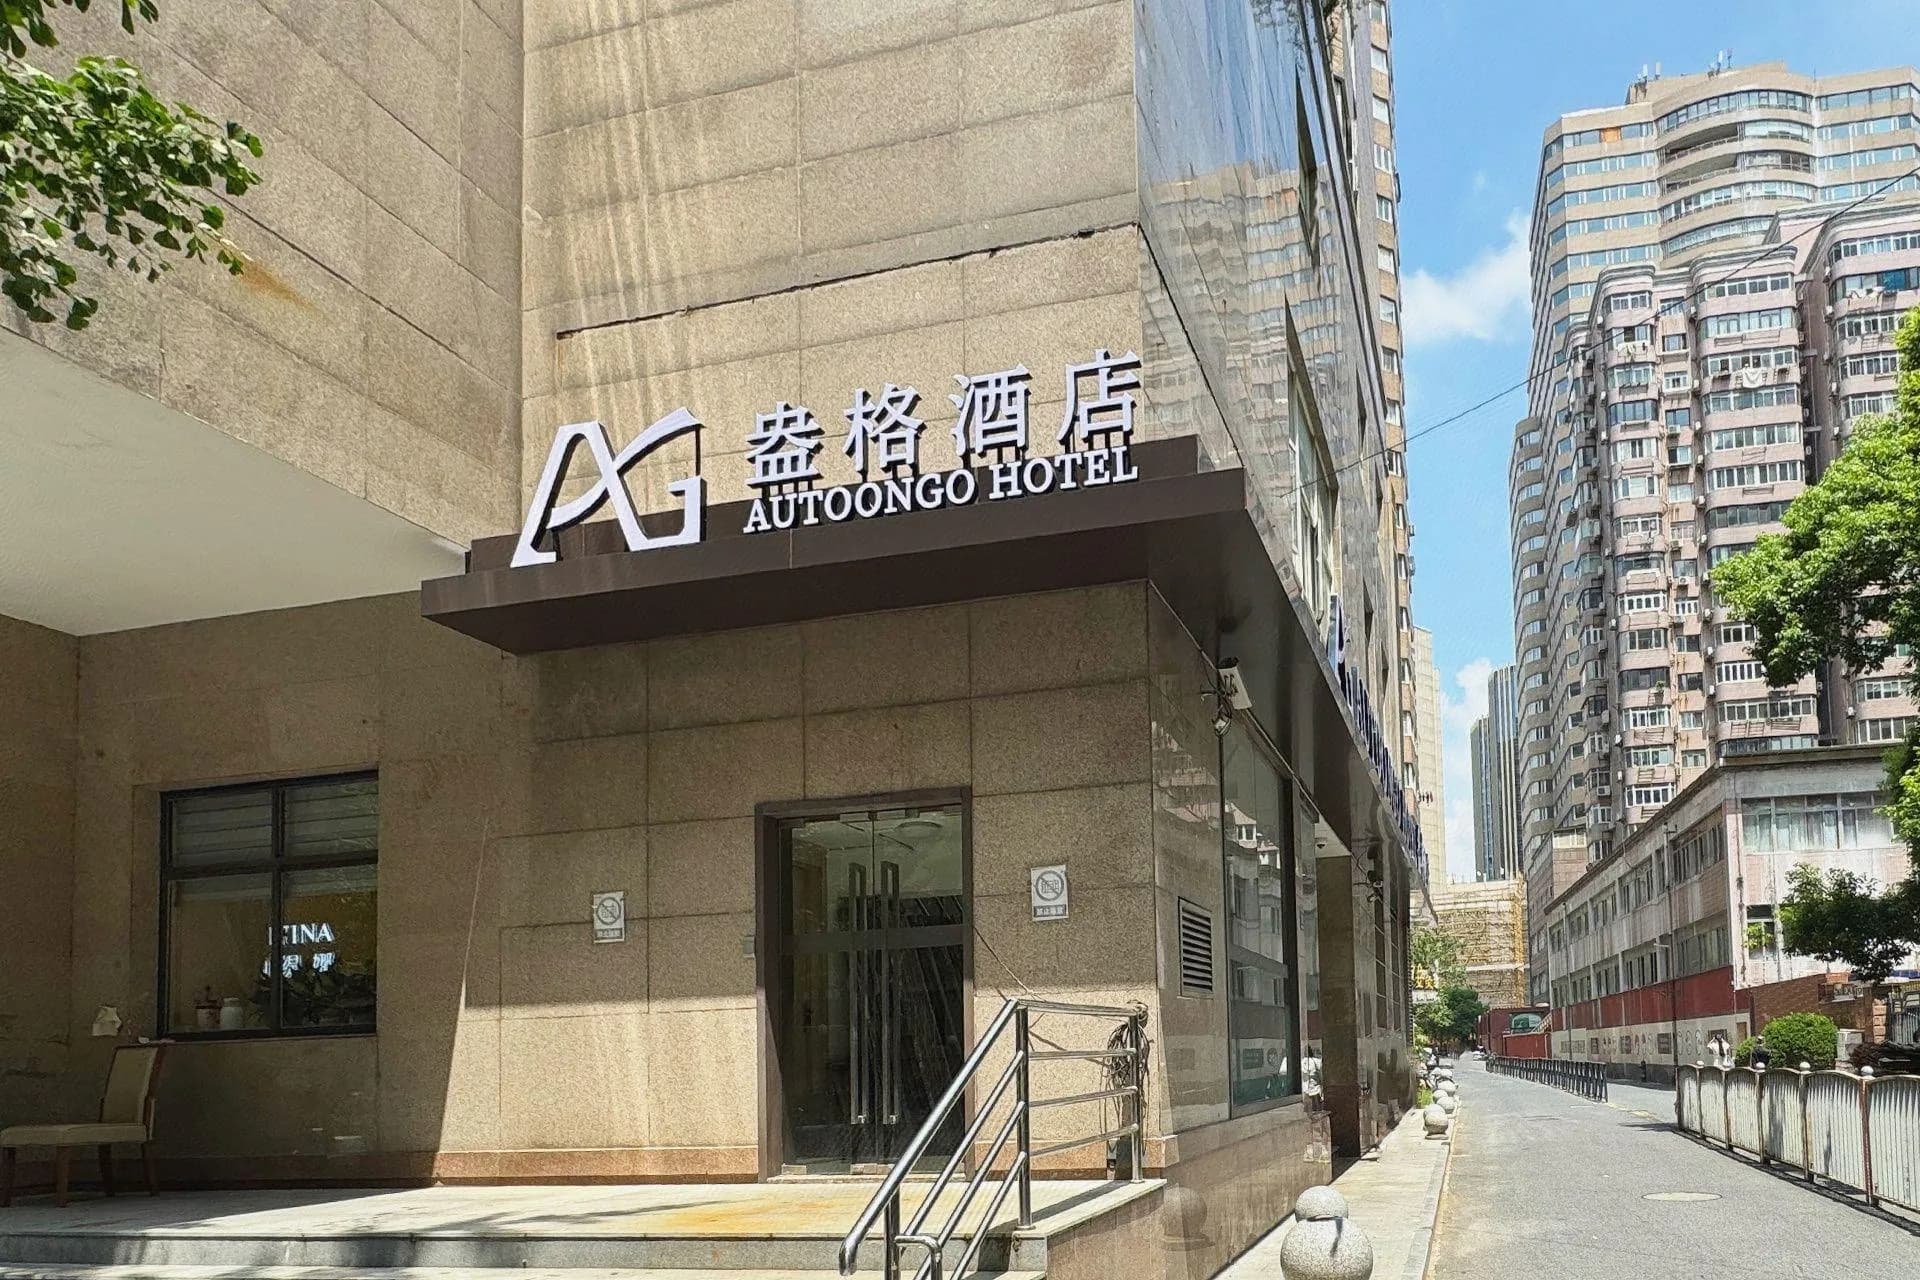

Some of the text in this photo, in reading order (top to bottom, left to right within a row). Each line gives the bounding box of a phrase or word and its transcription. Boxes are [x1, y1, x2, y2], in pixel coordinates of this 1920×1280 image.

[746, 348, 1142, 486] 盎格酒店
[743, 446, 1139, 534] AUTOONGO HOTEL
